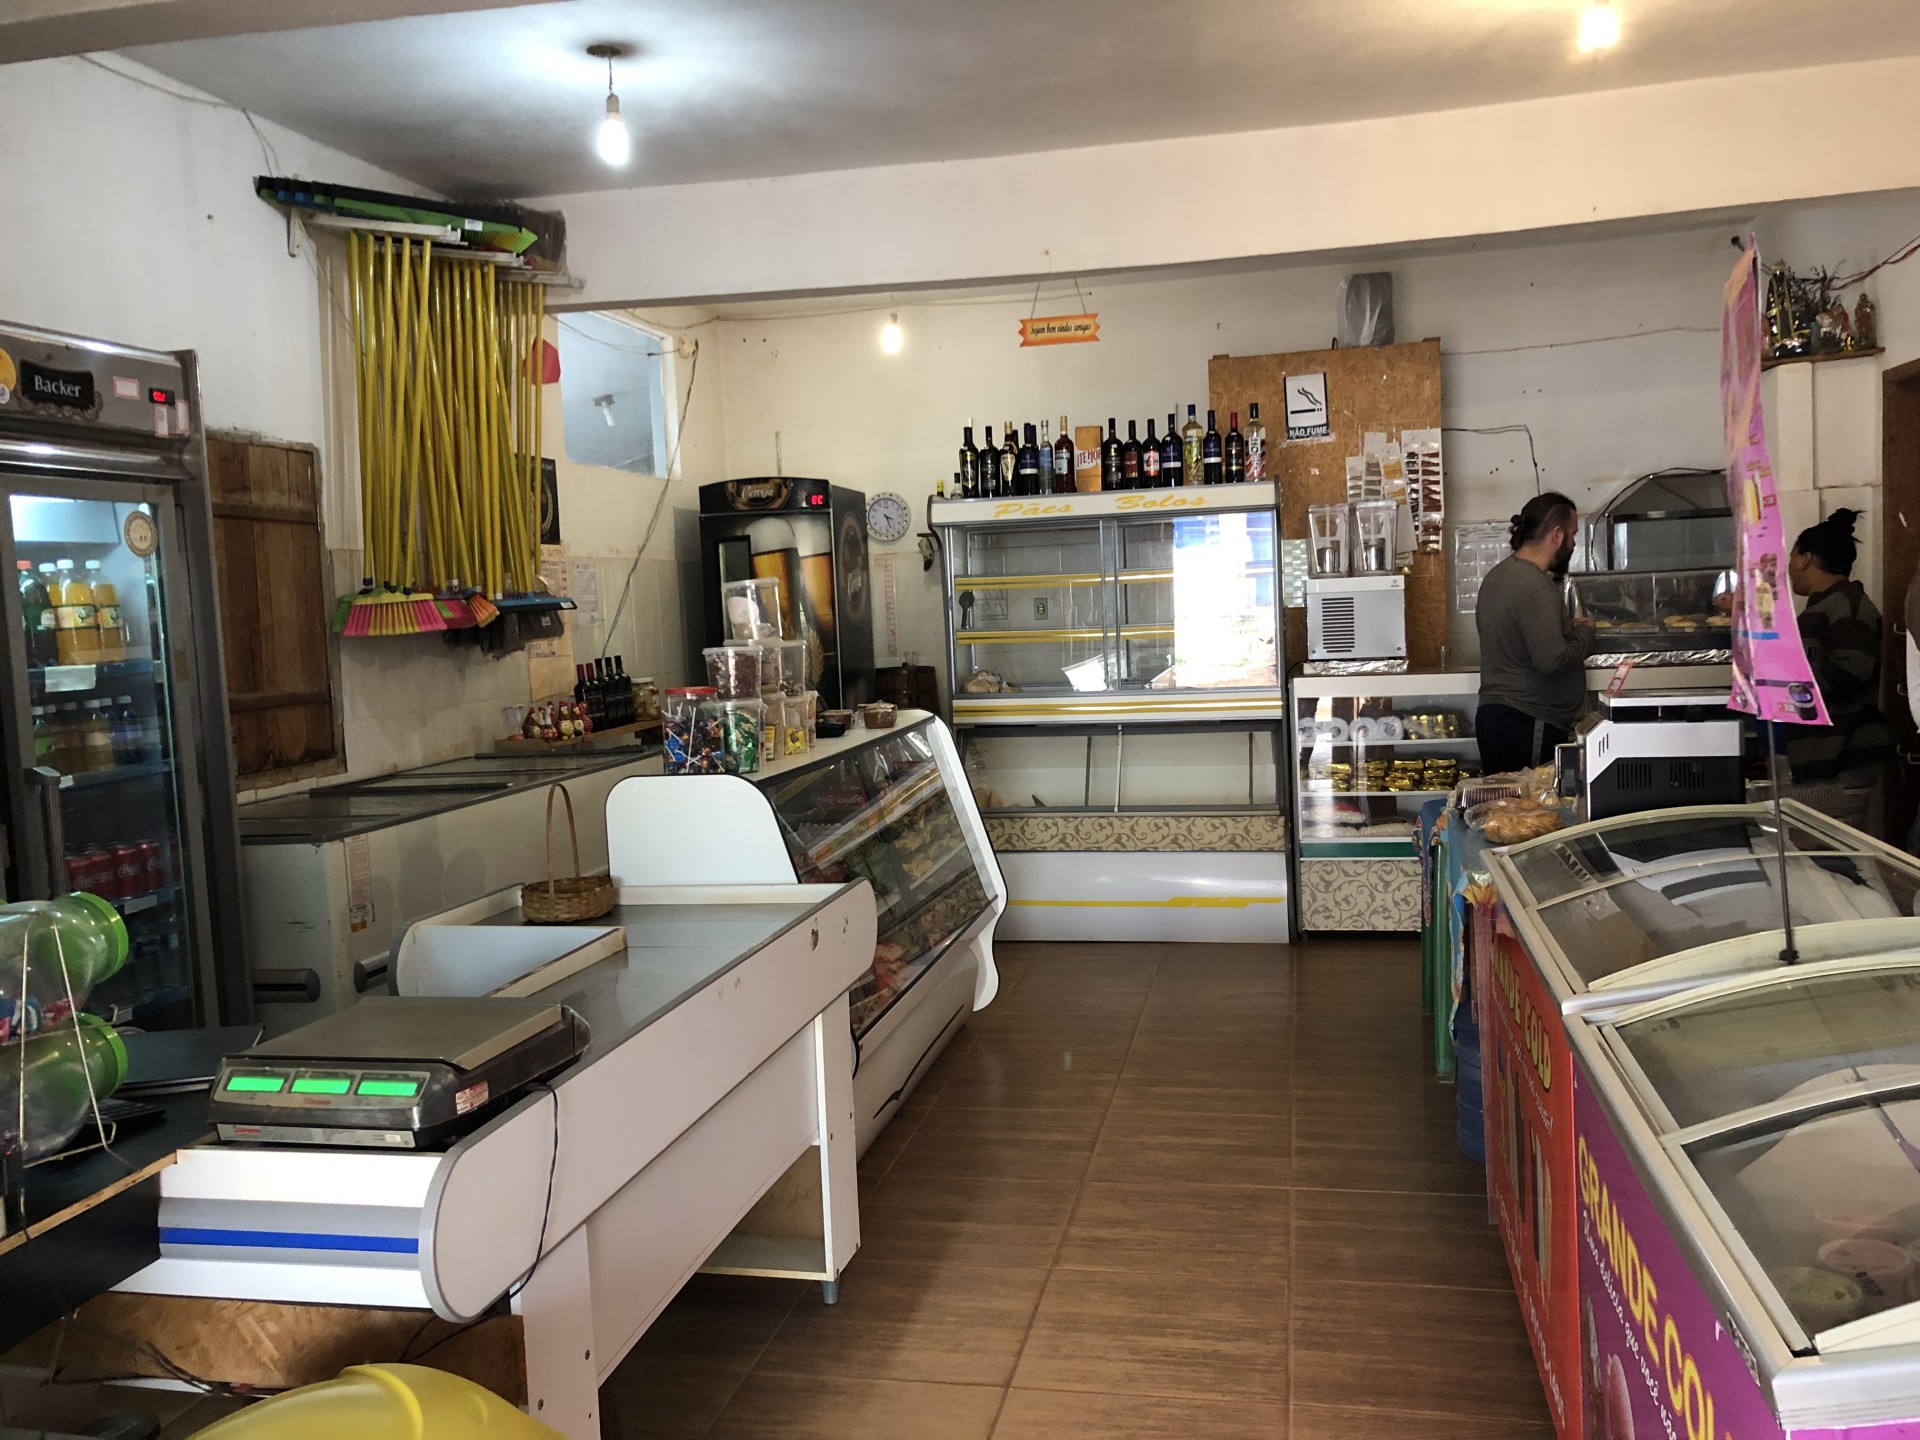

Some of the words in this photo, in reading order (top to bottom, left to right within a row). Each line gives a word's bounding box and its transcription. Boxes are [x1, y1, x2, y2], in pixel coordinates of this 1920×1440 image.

[1074, 323, 1091, 335] amigos
[34, 374, 82, 398] Backer
[1289, 427, 1306, 437] NÃO
[1306, 426, 1328, 436] FUME
[993, 502, 1073, 519] Pães
[1114, 495, 1208, 510] Bolos
[1524, 992, 1551, 1093] COLD
[1579, 1134, 1660, 1368] GRANDE
[1583, 1209, 1599, 1266] Uma
[1625, 1321, 1639, 1360] que
[1640, 1356, 1659, 1406] você
